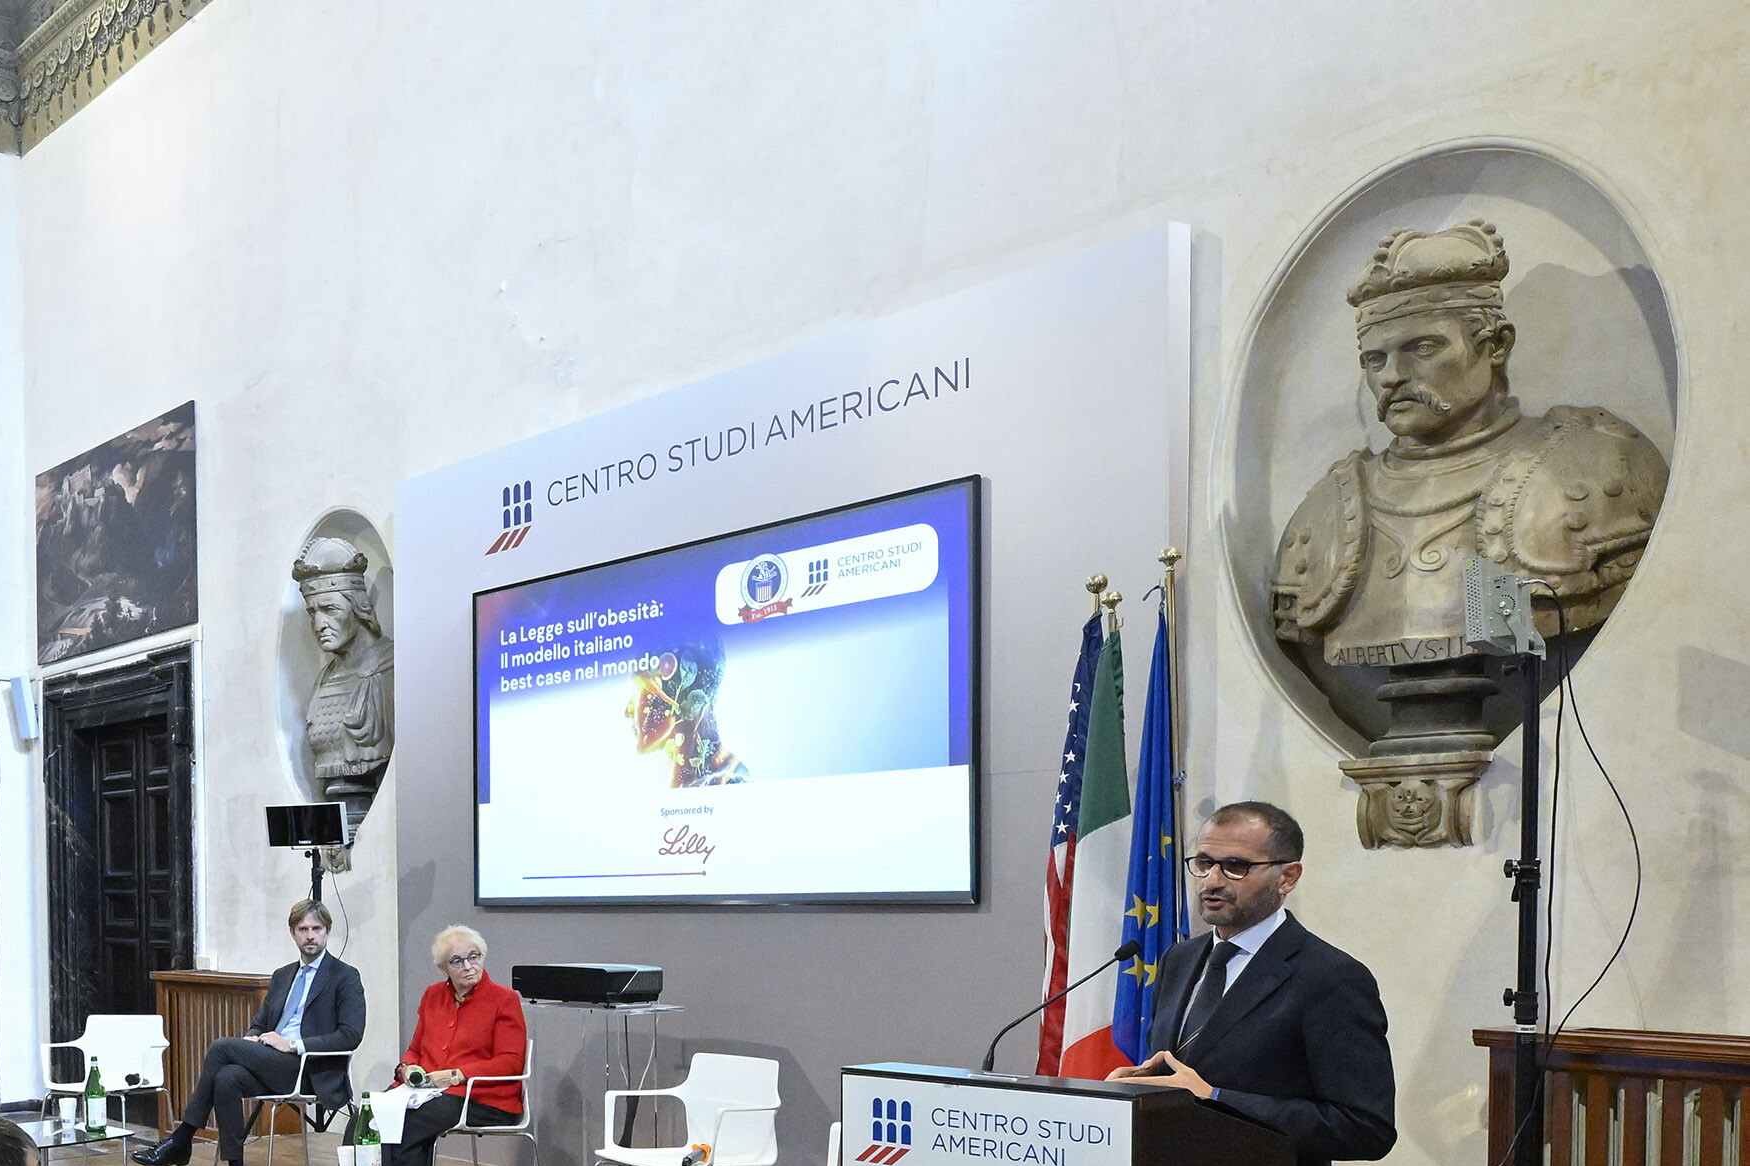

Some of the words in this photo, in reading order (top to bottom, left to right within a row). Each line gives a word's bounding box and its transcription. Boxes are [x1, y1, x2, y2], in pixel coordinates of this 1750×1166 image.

[546, 452, 657, 506] CENTRO
[667, 421, 755, 473] STUDI
[764, 357, 970, 447] AMERICANI
[837, 549, 884, 567] CENTRO
[887, 541, 922, 557] STUDI
[837, 558, 901, 579] AMERICANI
[500, 630, 517, 646] La
[520, 622, 564, 644] Legge
[567, 600, 664, 634] sull'obesità:
[764, 603, 778, 615] 1915
[500, 652, 509, 669] Il
[511, 642, 571, 668] modello
[574, 634, 634, 657] italiano
[500, 673, 533, 692] best
[536, 669, 571, 687] case
[575, 661, 599, 681] nel
[602, 652, 660, 677] mondo
[660, 805, 702, 818] Sponsored
[704, 805, 714, 815] by
[658, 824, 716, 865] Lilly
[931, 1107, 1028, 1136] CENTRO
[1038, 1119, 1112, 1146] STUDI
